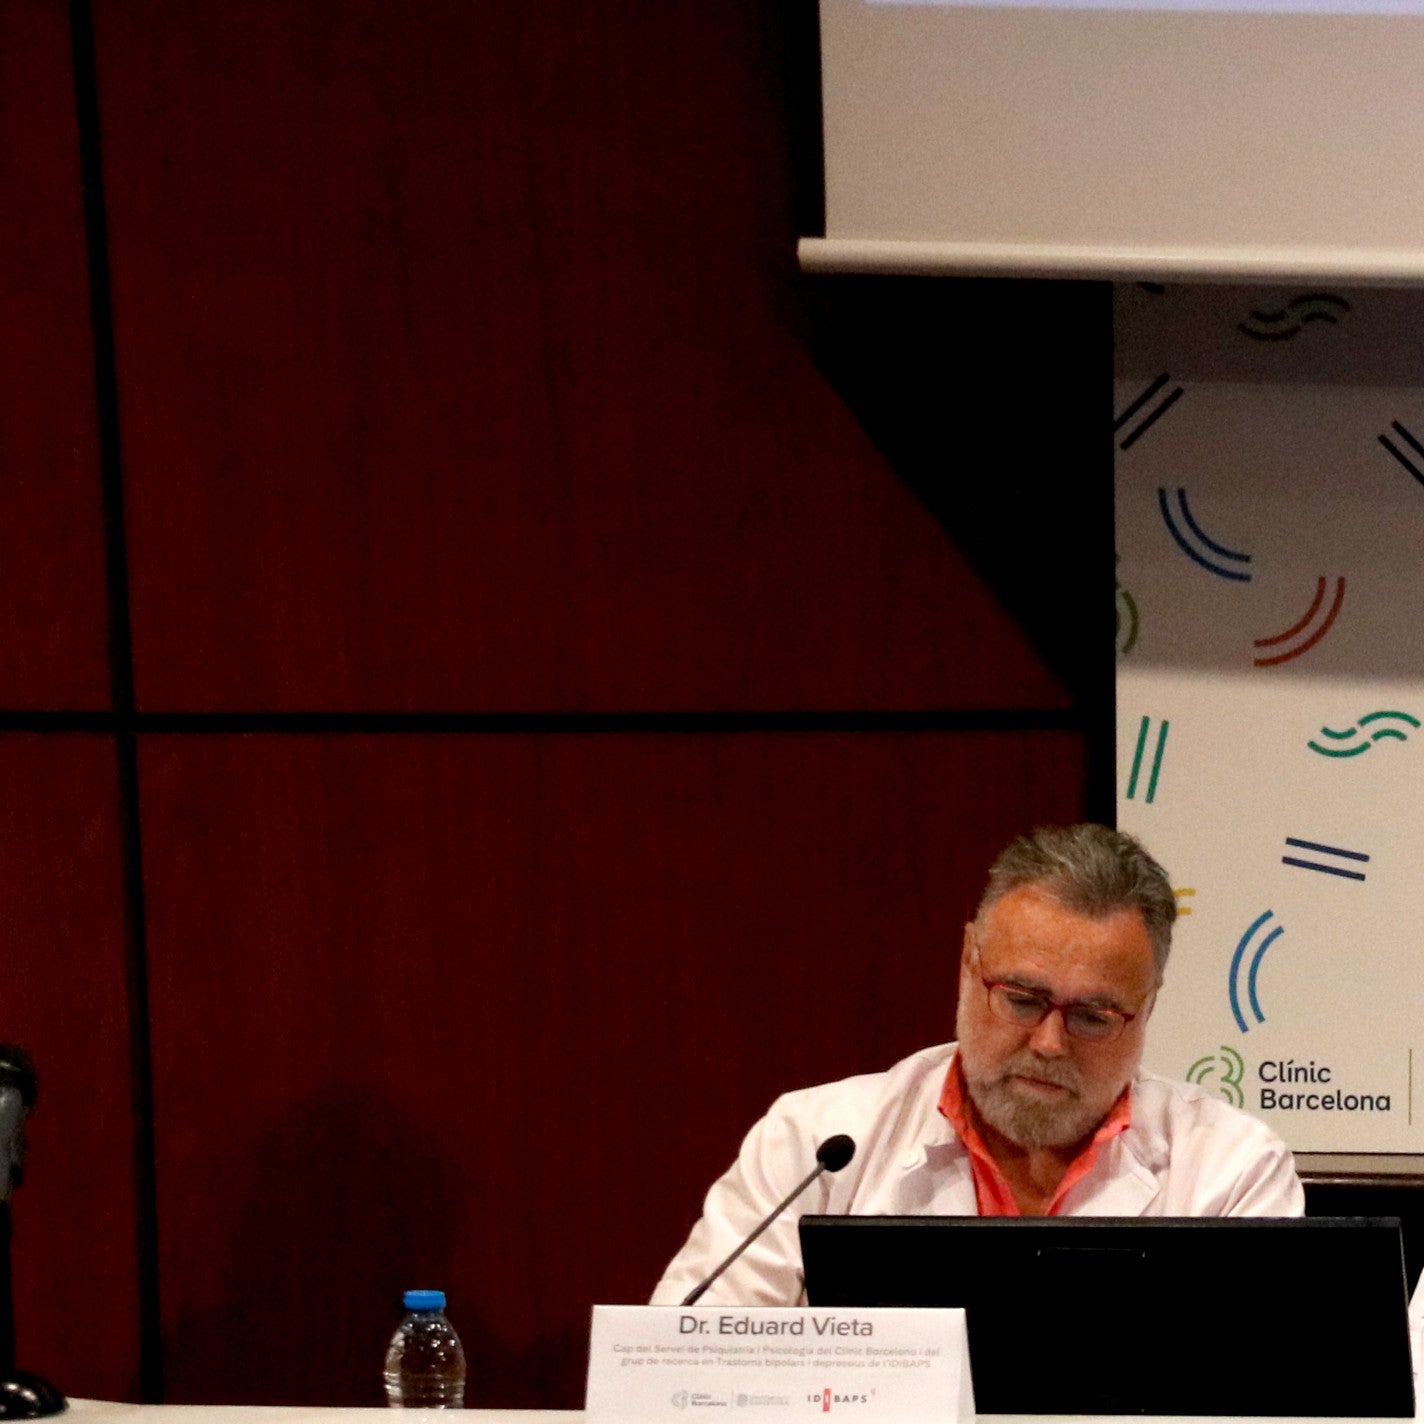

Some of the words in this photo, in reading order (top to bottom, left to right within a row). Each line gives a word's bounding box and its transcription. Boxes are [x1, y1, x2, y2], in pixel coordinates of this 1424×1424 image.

[1259, 1060, 1330, 1083] Clínic
[1261, 1088, 1390, 1111] Barcelona
[679, 1315, 709, 1334] Dr.
[718, 1315, 804, 1336] Eduard
[811, 1316, 873, 1336] Vieta
